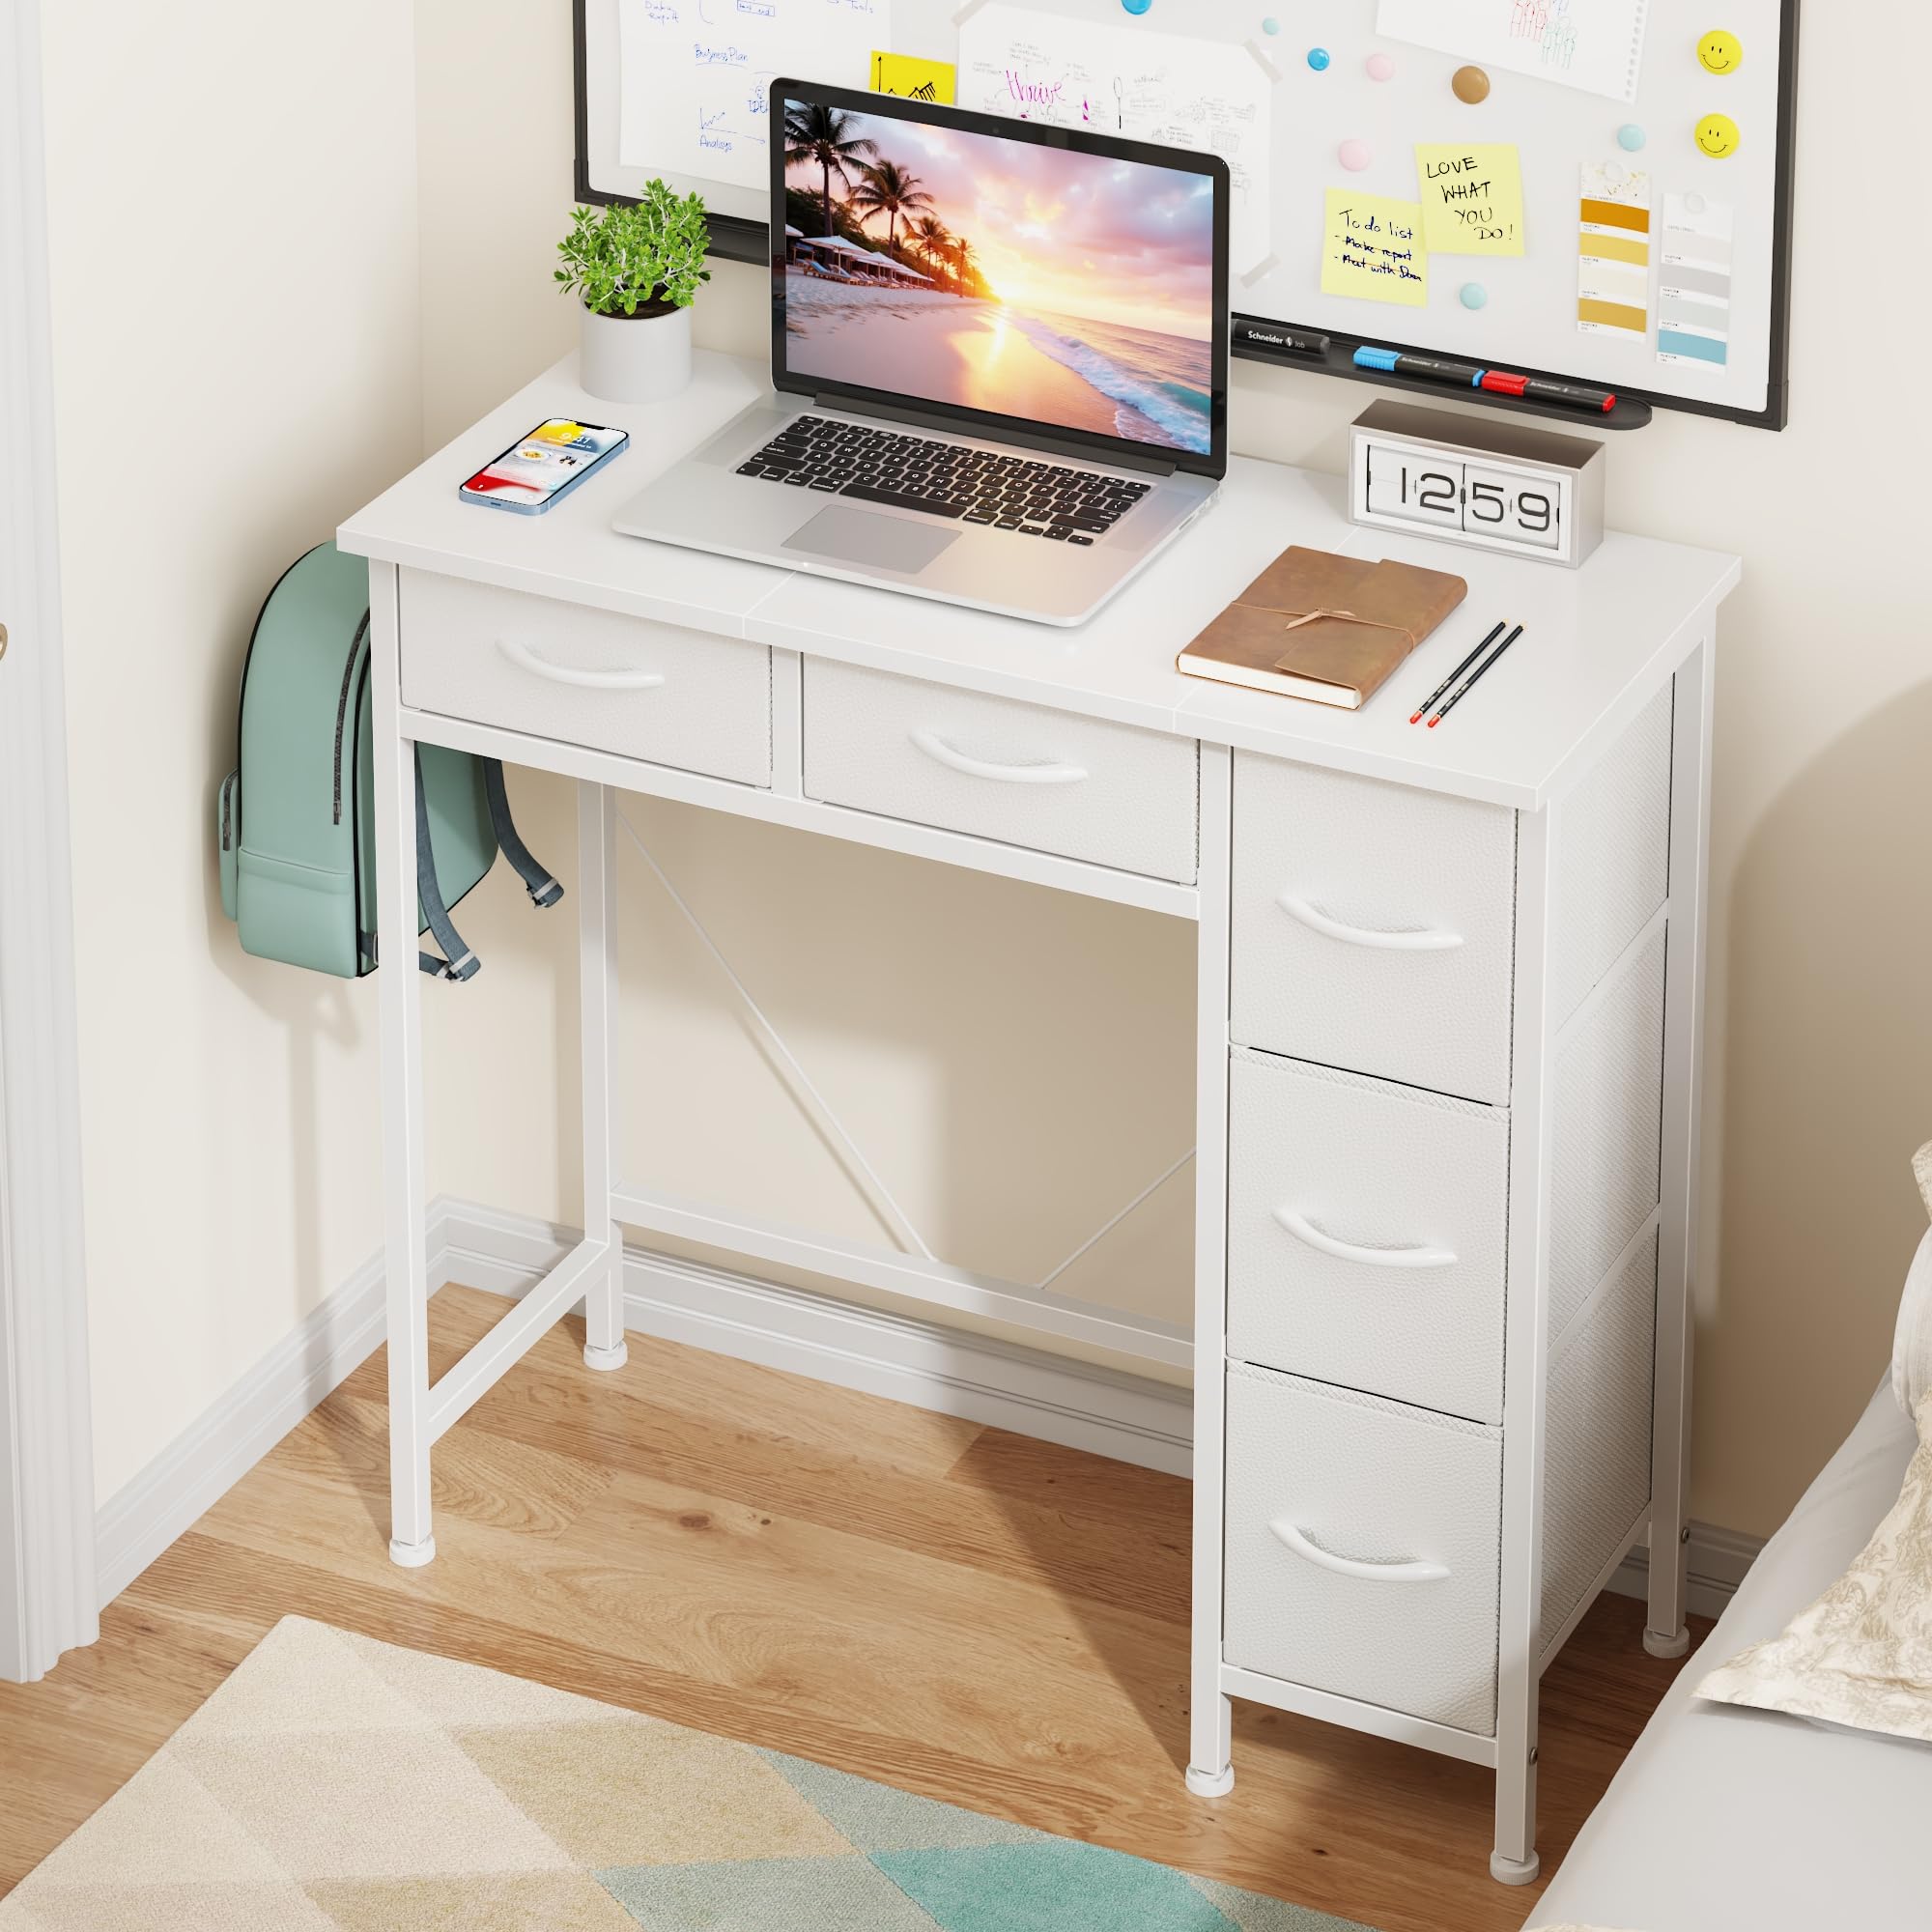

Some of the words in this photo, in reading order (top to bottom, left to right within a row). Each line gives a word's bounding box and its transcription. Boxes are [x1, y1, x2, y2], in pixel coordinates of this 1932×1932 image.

[728, 46, 749, 61] Plan
[1427, 157, 1478, 179] LOVE
[1441, 182, 1491, 204] WHAT
[1339, 209, 1361, 229] To
[1364, 216, 1381, 233] do
[1389, 221, 1414, 240] list
[1454, 207, 1493, 225] YOU
[1345, 236, 1375, 254] Make
[1381, 248, 1413, 263] report
[1371, 262, 1397, 275] with
[1247, 329, 1285, 345] Schneider
[1401, 355, 1434, 368] Schneider
[1401, 467, 1457, 514] 12
[1471, 482, 1551, 532] 59
